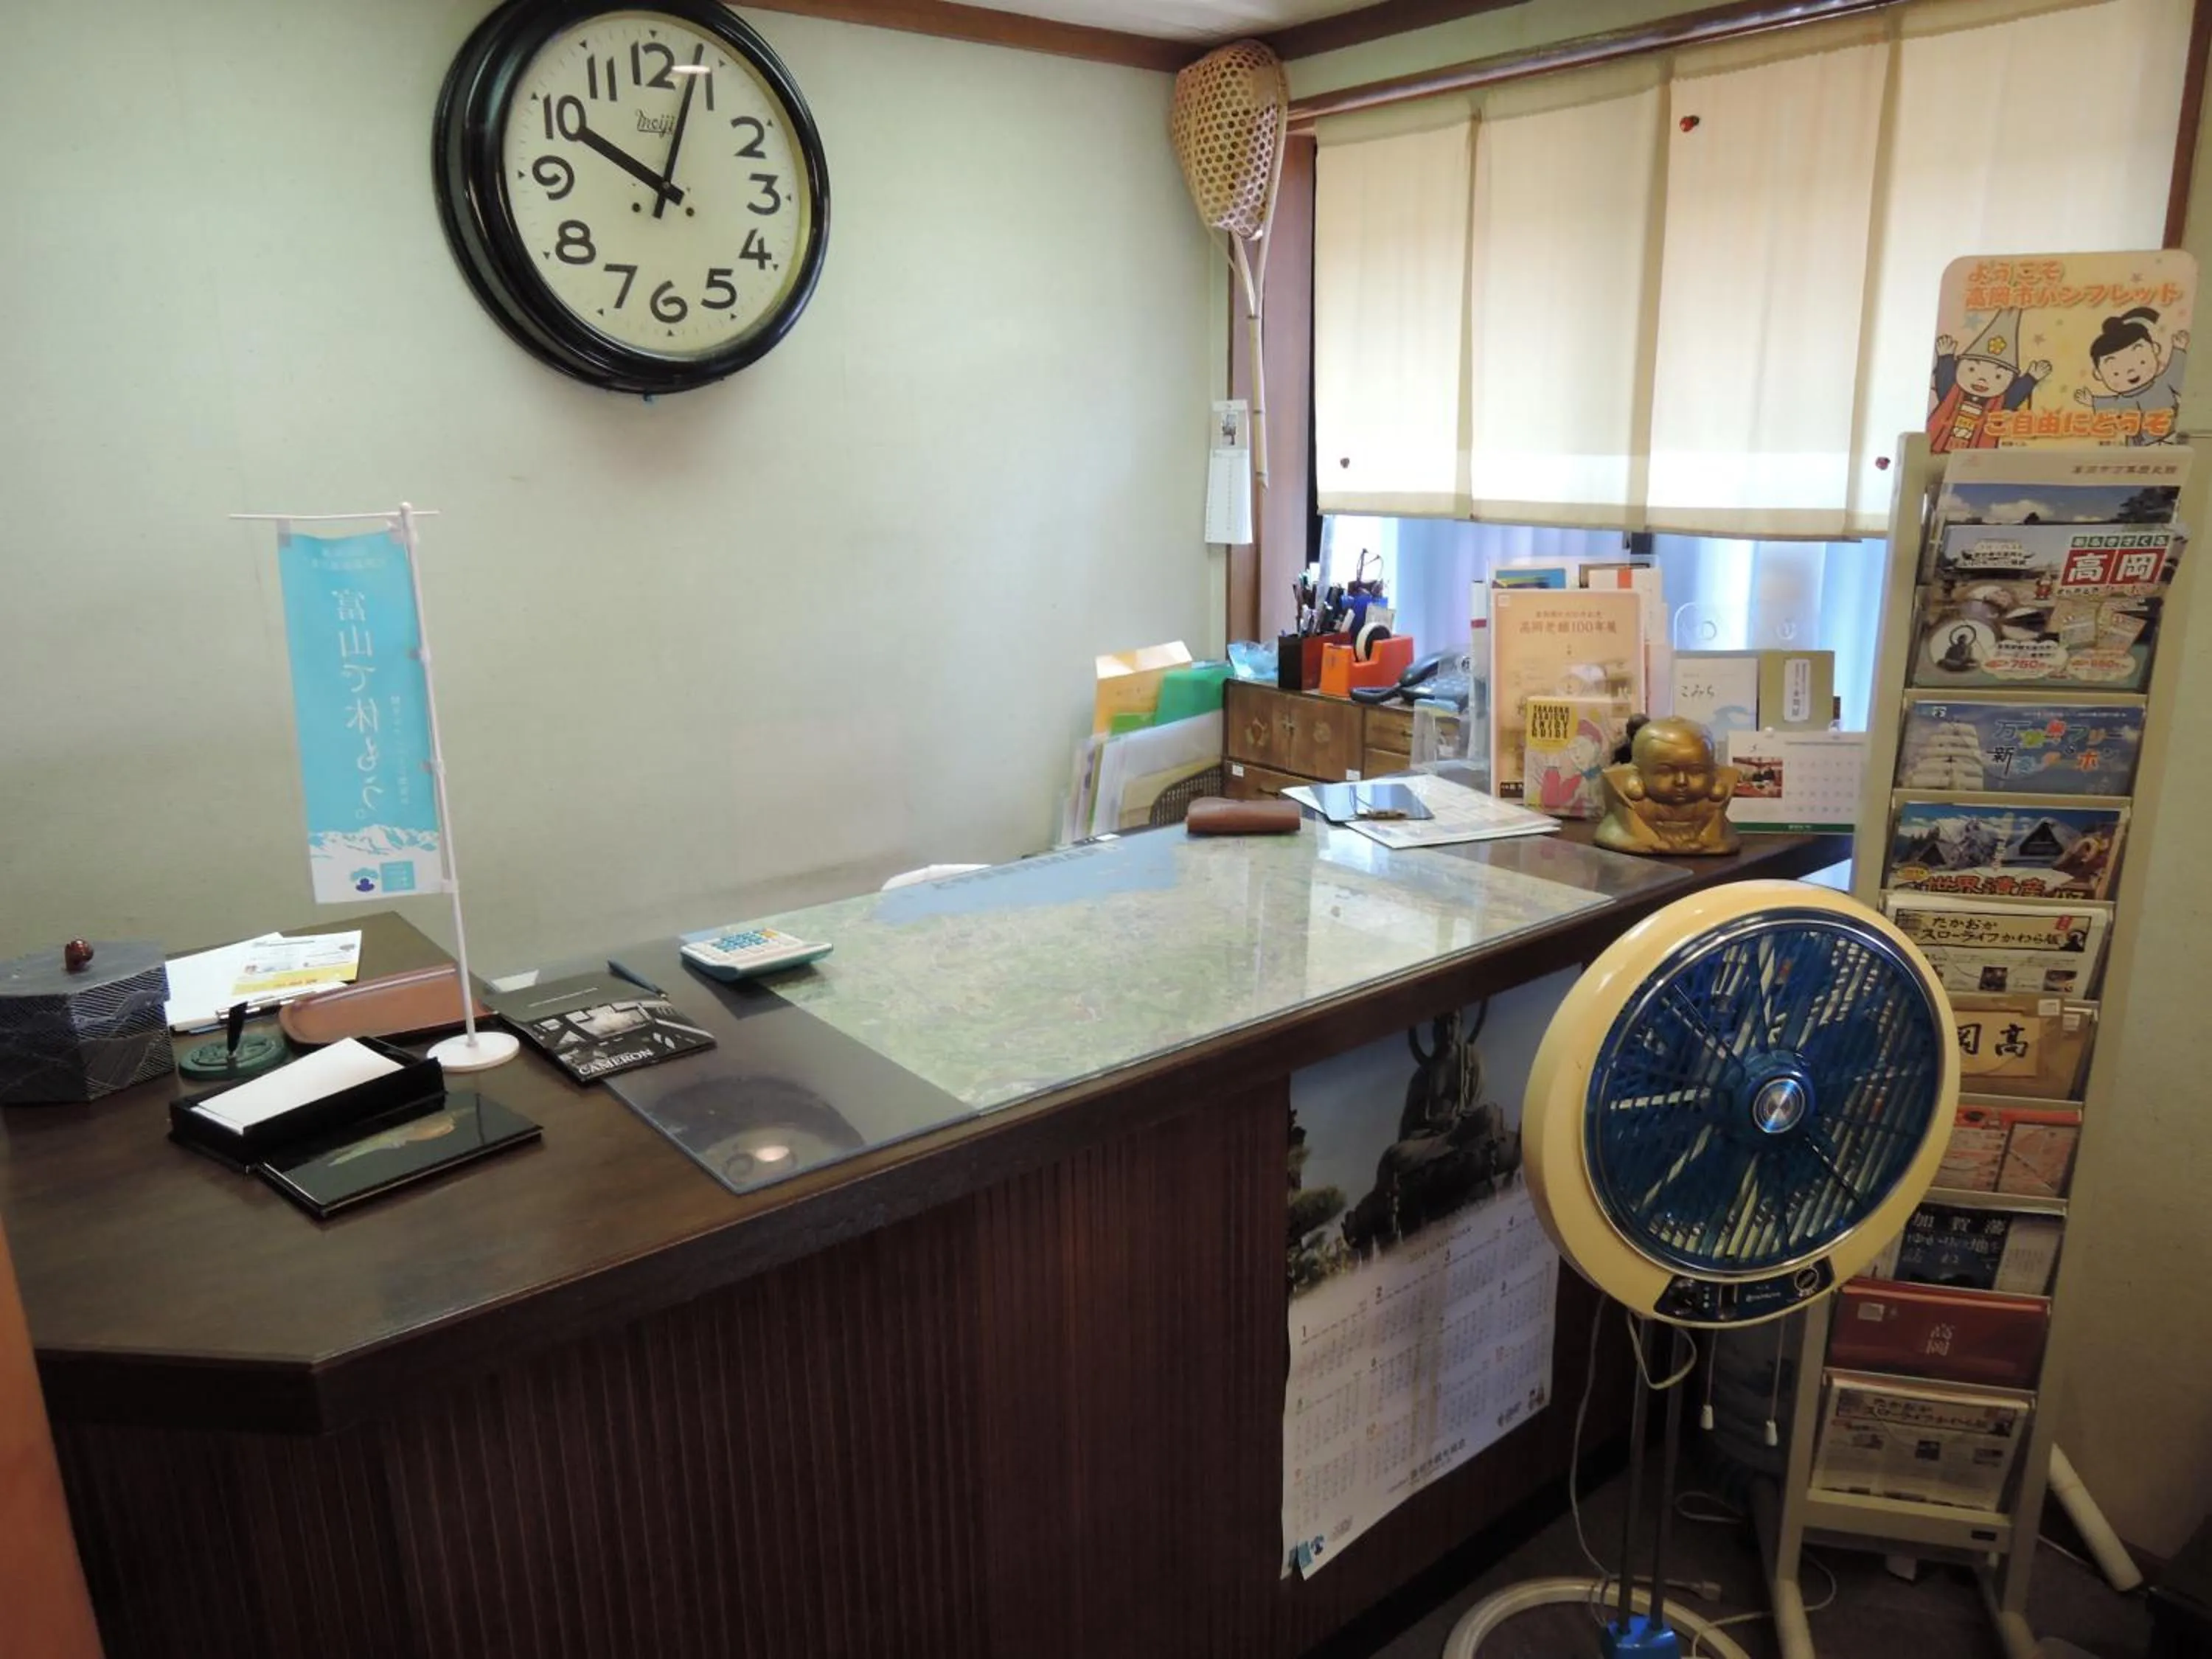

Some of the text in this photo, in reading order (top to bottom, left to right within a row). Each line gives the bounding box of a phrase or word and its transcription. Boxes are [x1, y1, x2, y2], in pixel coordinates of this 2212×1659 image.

[586, 54, 617, 101] 11
[630, 41, 676, 89] 12
[543, 94, 586, 142] 10
[731, 116, 766, 159] 2
[532, 155, 574, 200] 9
[747, 174, 780, 215] 3
[555, 220, 596, 265] 8
[739, 229, 772, 270] 4
[603, 265, 638, 308] 7
[701, 268, 737, 309] 5
[1967, 261, 2062, 285] ようこそ
[650, 280, 688, 323] 6
[1983, 410, 2174, 439] ご自由にどうぞ
[2067, 550, 2156, 583] 高岡
[1932, 917, 1998, 931] たかおか
[579, 1048, 655, 1075] CAMERON
